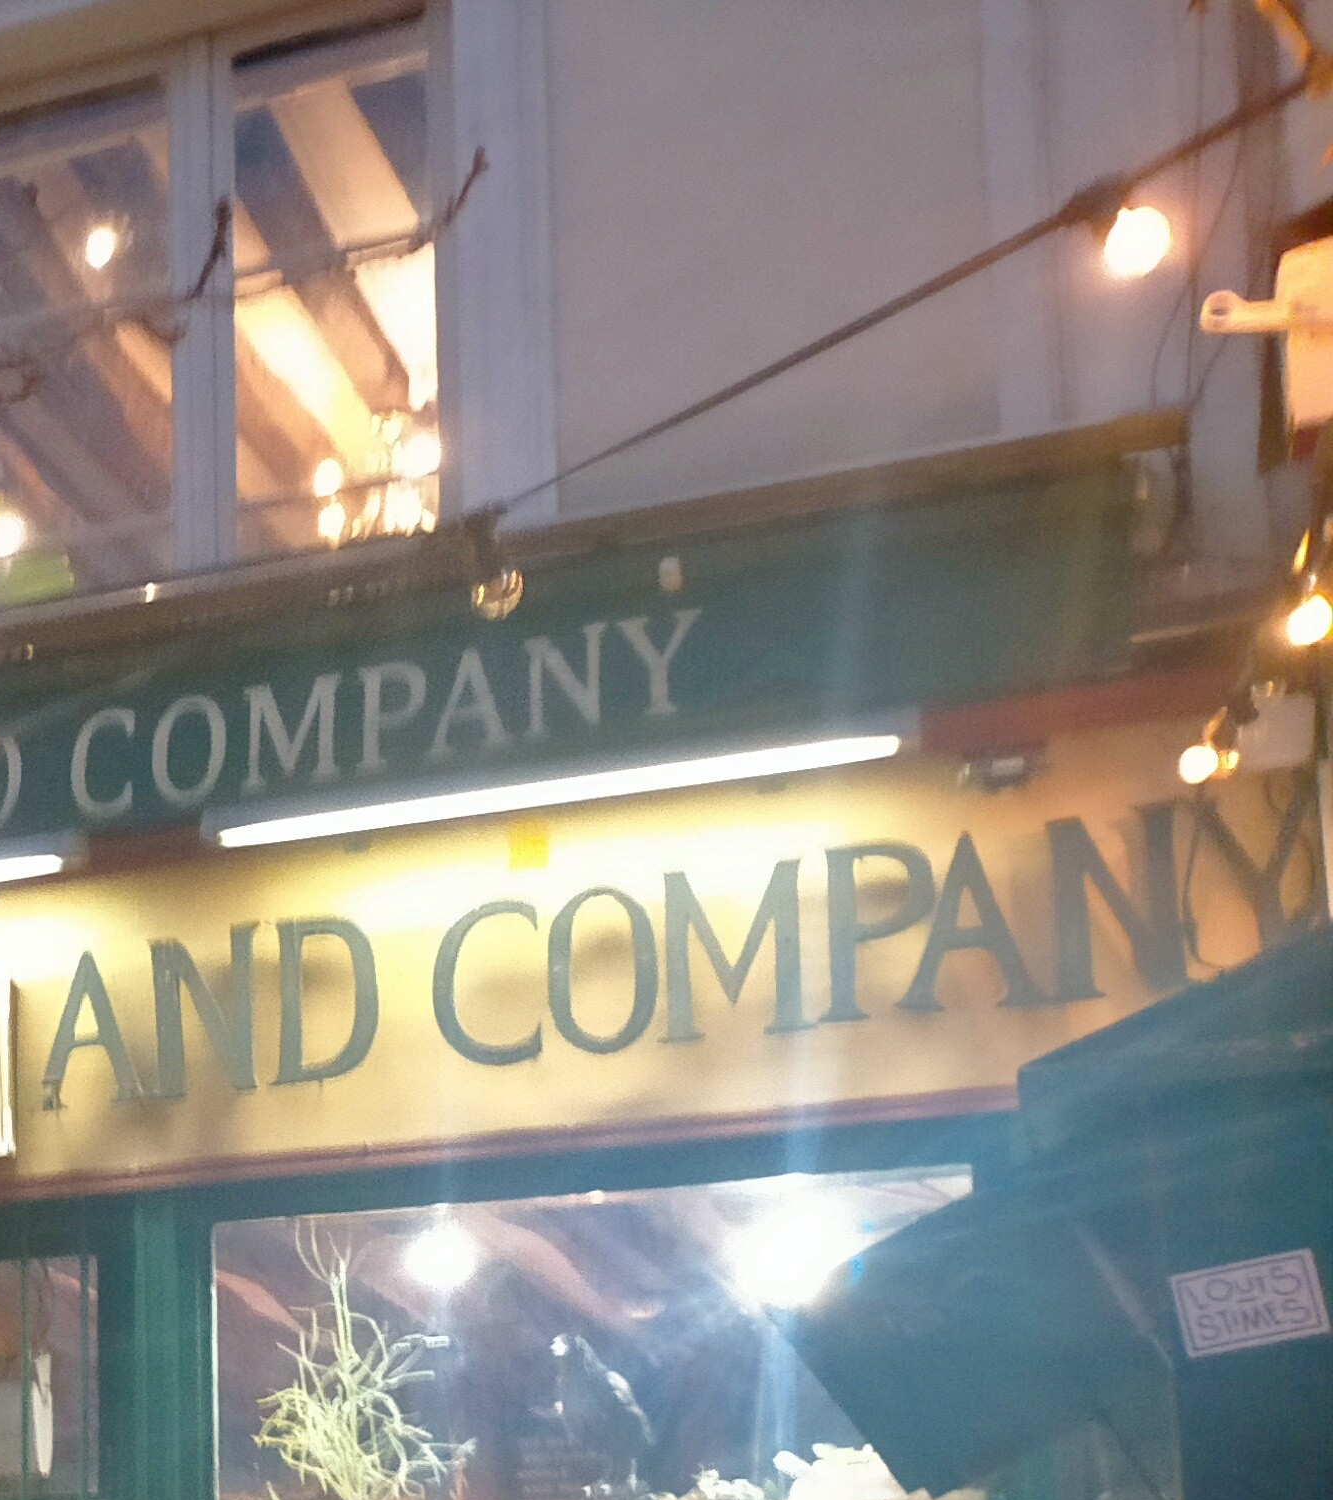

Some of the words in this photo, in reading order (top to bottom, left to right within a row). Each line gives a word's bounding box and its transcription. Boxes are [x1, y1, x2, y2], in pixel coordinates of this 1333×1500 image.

[69, 607, 703, 819] COMPANY
[41, 913, 380, 1111] AND
[432, 787, 1311, 1066] COMPANY
